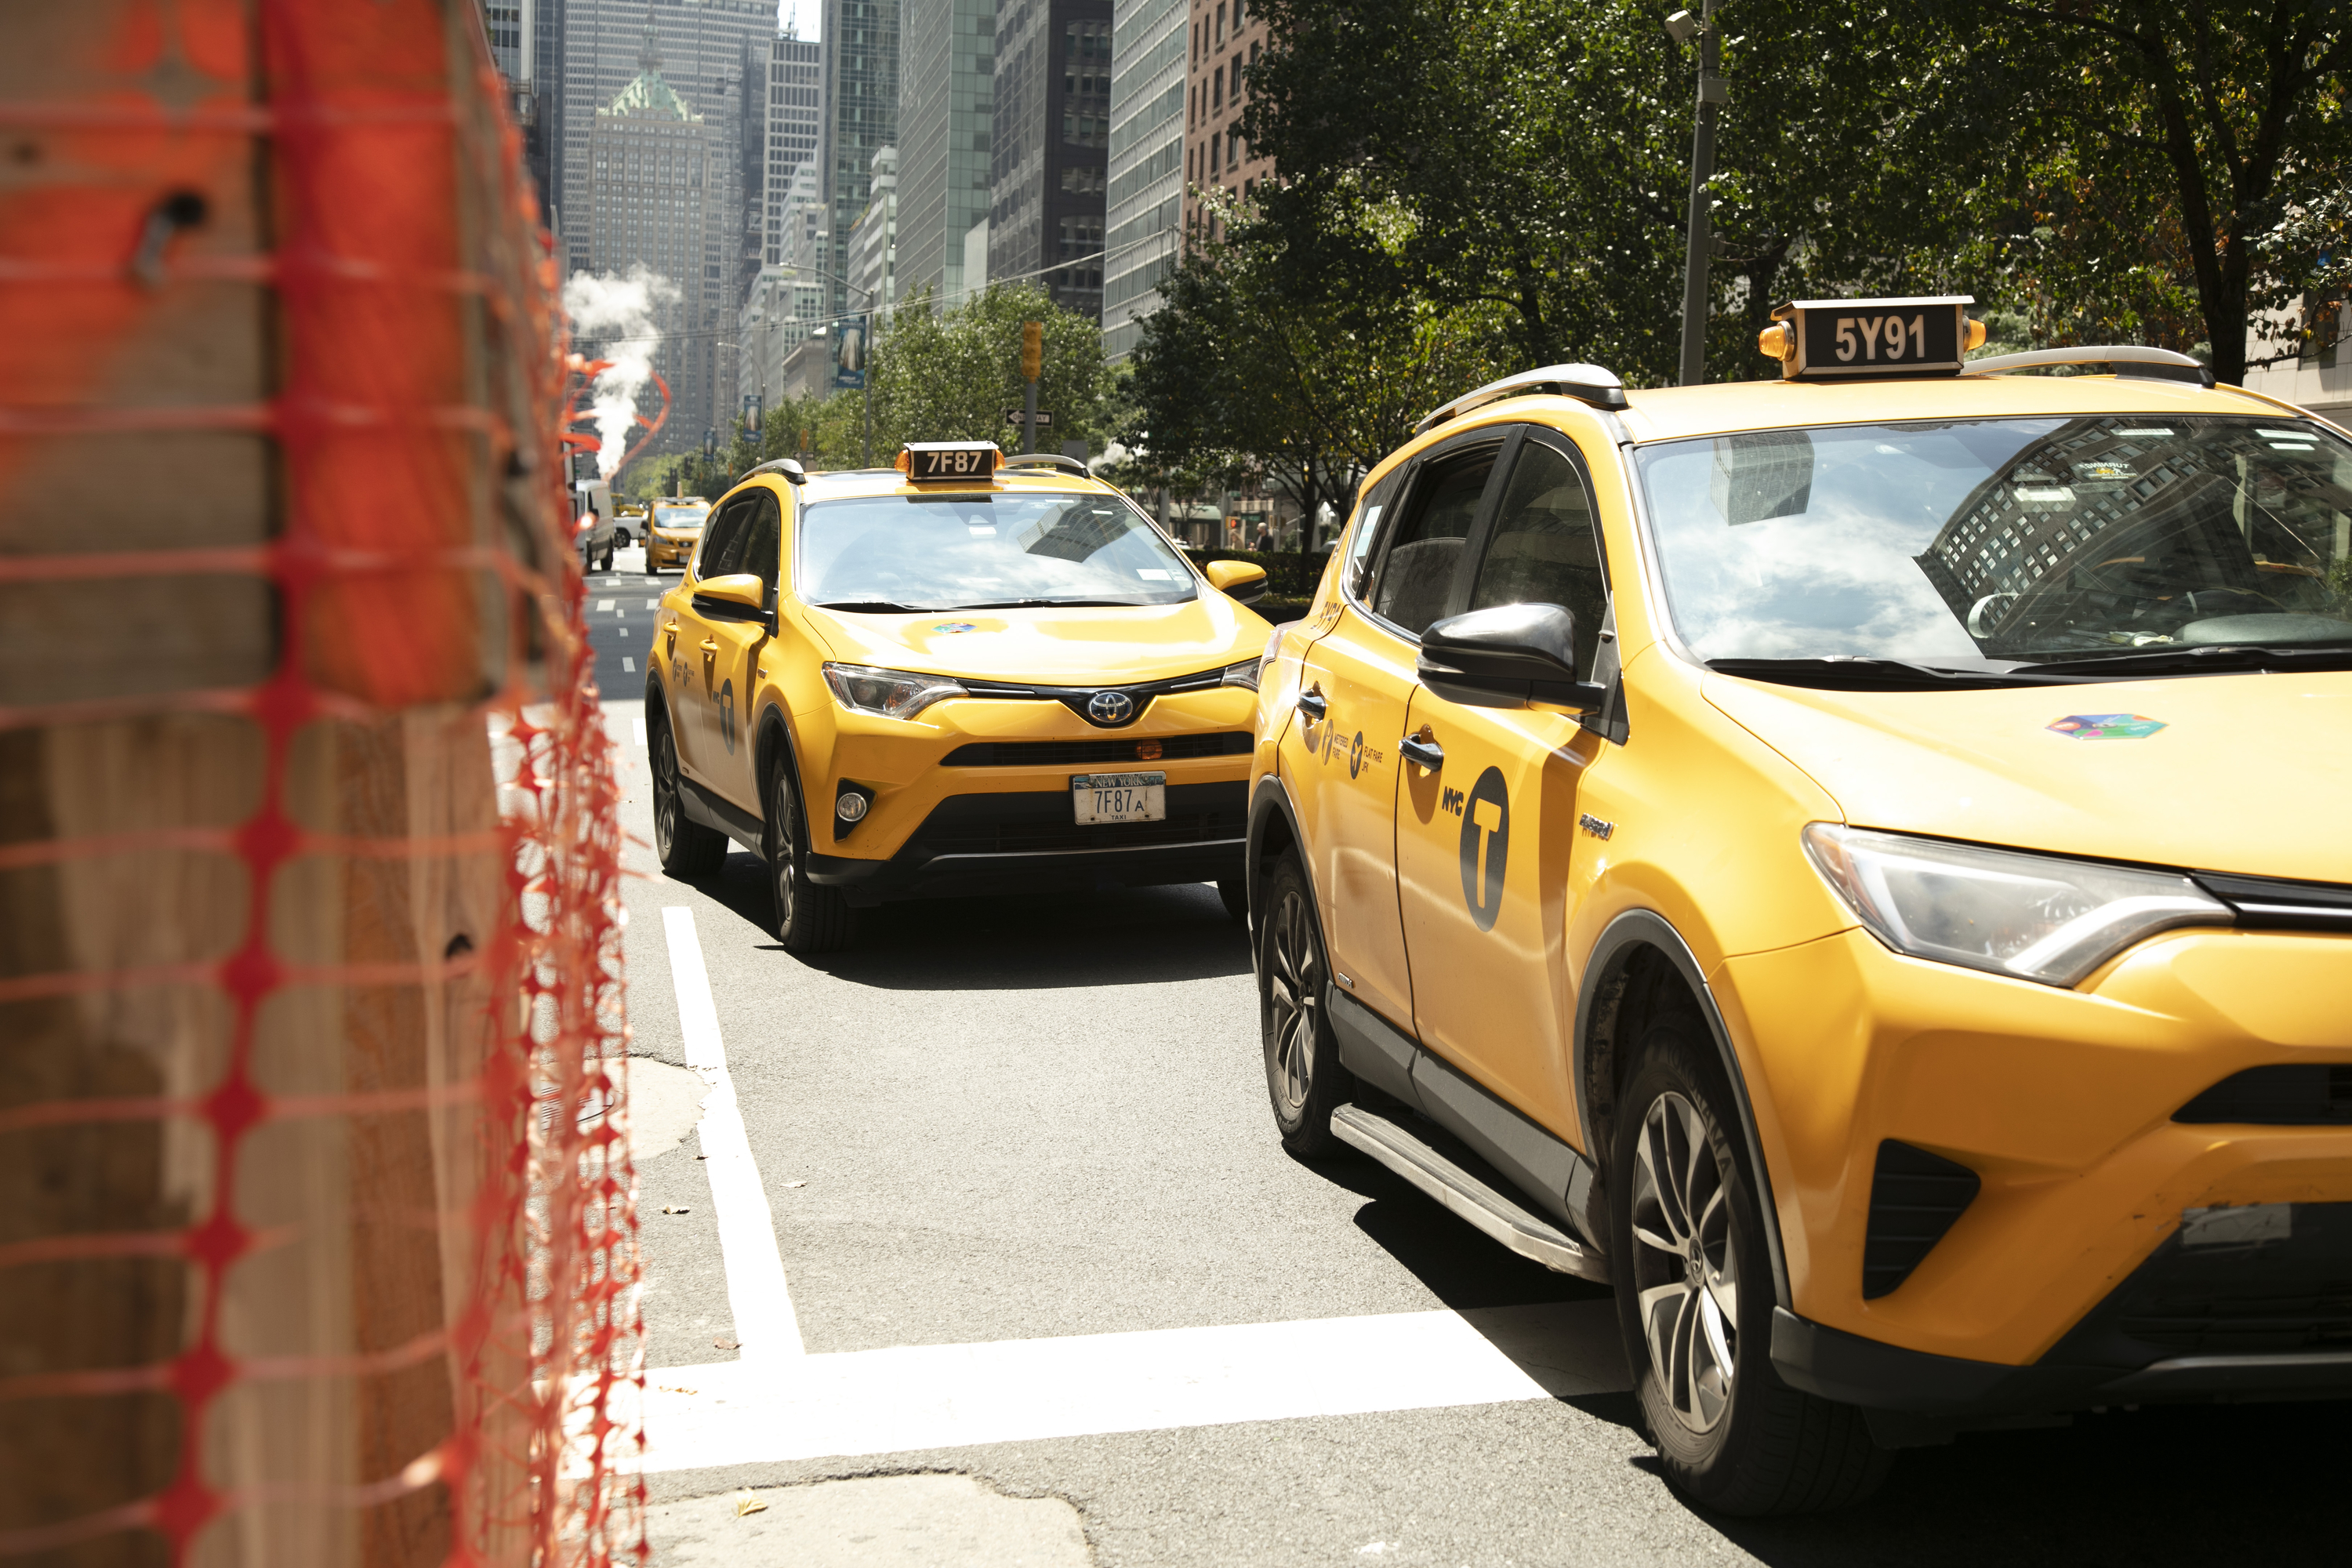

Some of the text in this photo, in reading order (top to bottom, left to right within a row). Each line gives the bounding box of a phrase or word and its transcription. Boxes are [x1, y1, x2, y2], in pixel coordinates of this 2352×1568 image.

[1835, 314, 1926, 362] 5Y91
[927, 451, 982, 473] 7F87
[1364, 746, 1383, 764] FLAT FARE
[1361, 760, 1370, 773] JFK
[1095, 776, 1143, 788] NEW YORK
[1441, 786, 1502, 909] NYC T
